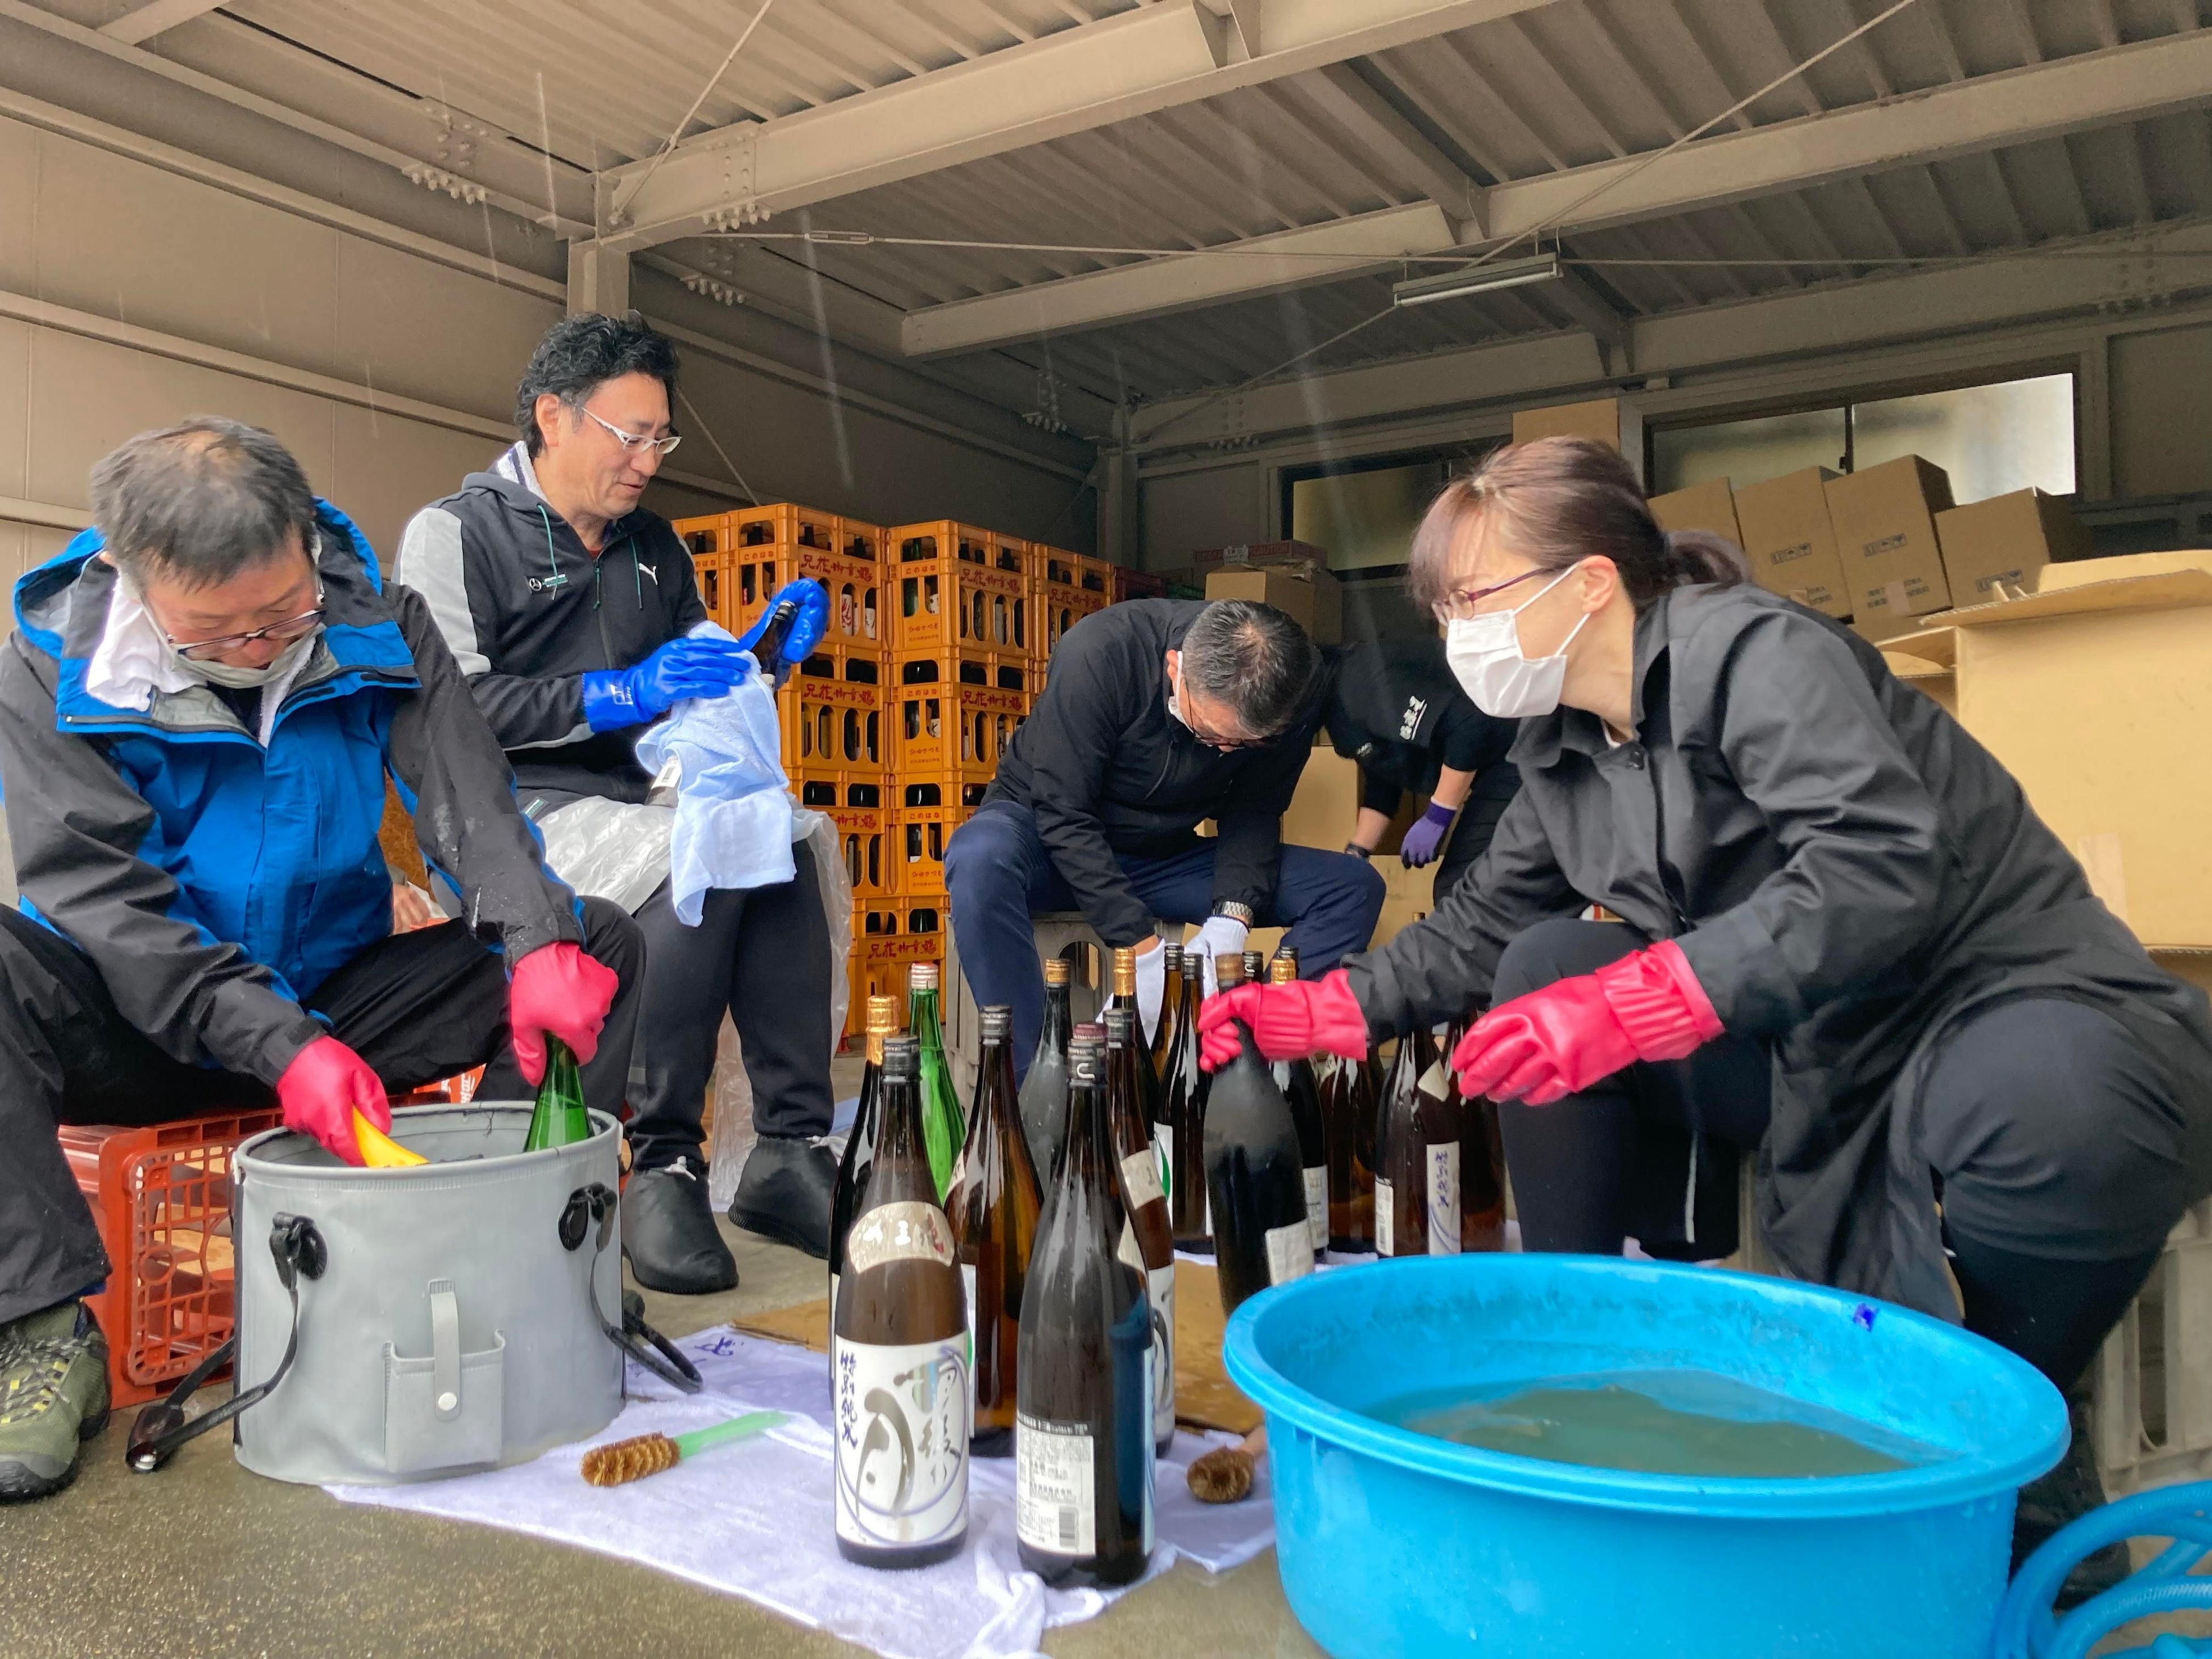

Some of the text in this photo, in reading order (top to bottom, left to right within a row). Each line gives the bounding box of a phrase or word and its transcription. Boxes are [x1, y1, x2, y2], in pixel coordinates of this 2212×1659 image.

[744, 550, 774, 560] このはな
[695, 559, 716, 567] のはな
[906, 565, 936, 575] このはな
[906, 688, 938, 697] このはな
[909, 811, 940, 820] このはな
[829, 812, 877, 830] 御幸鶴
[839, 1349, 859, 1450] 特別純米
